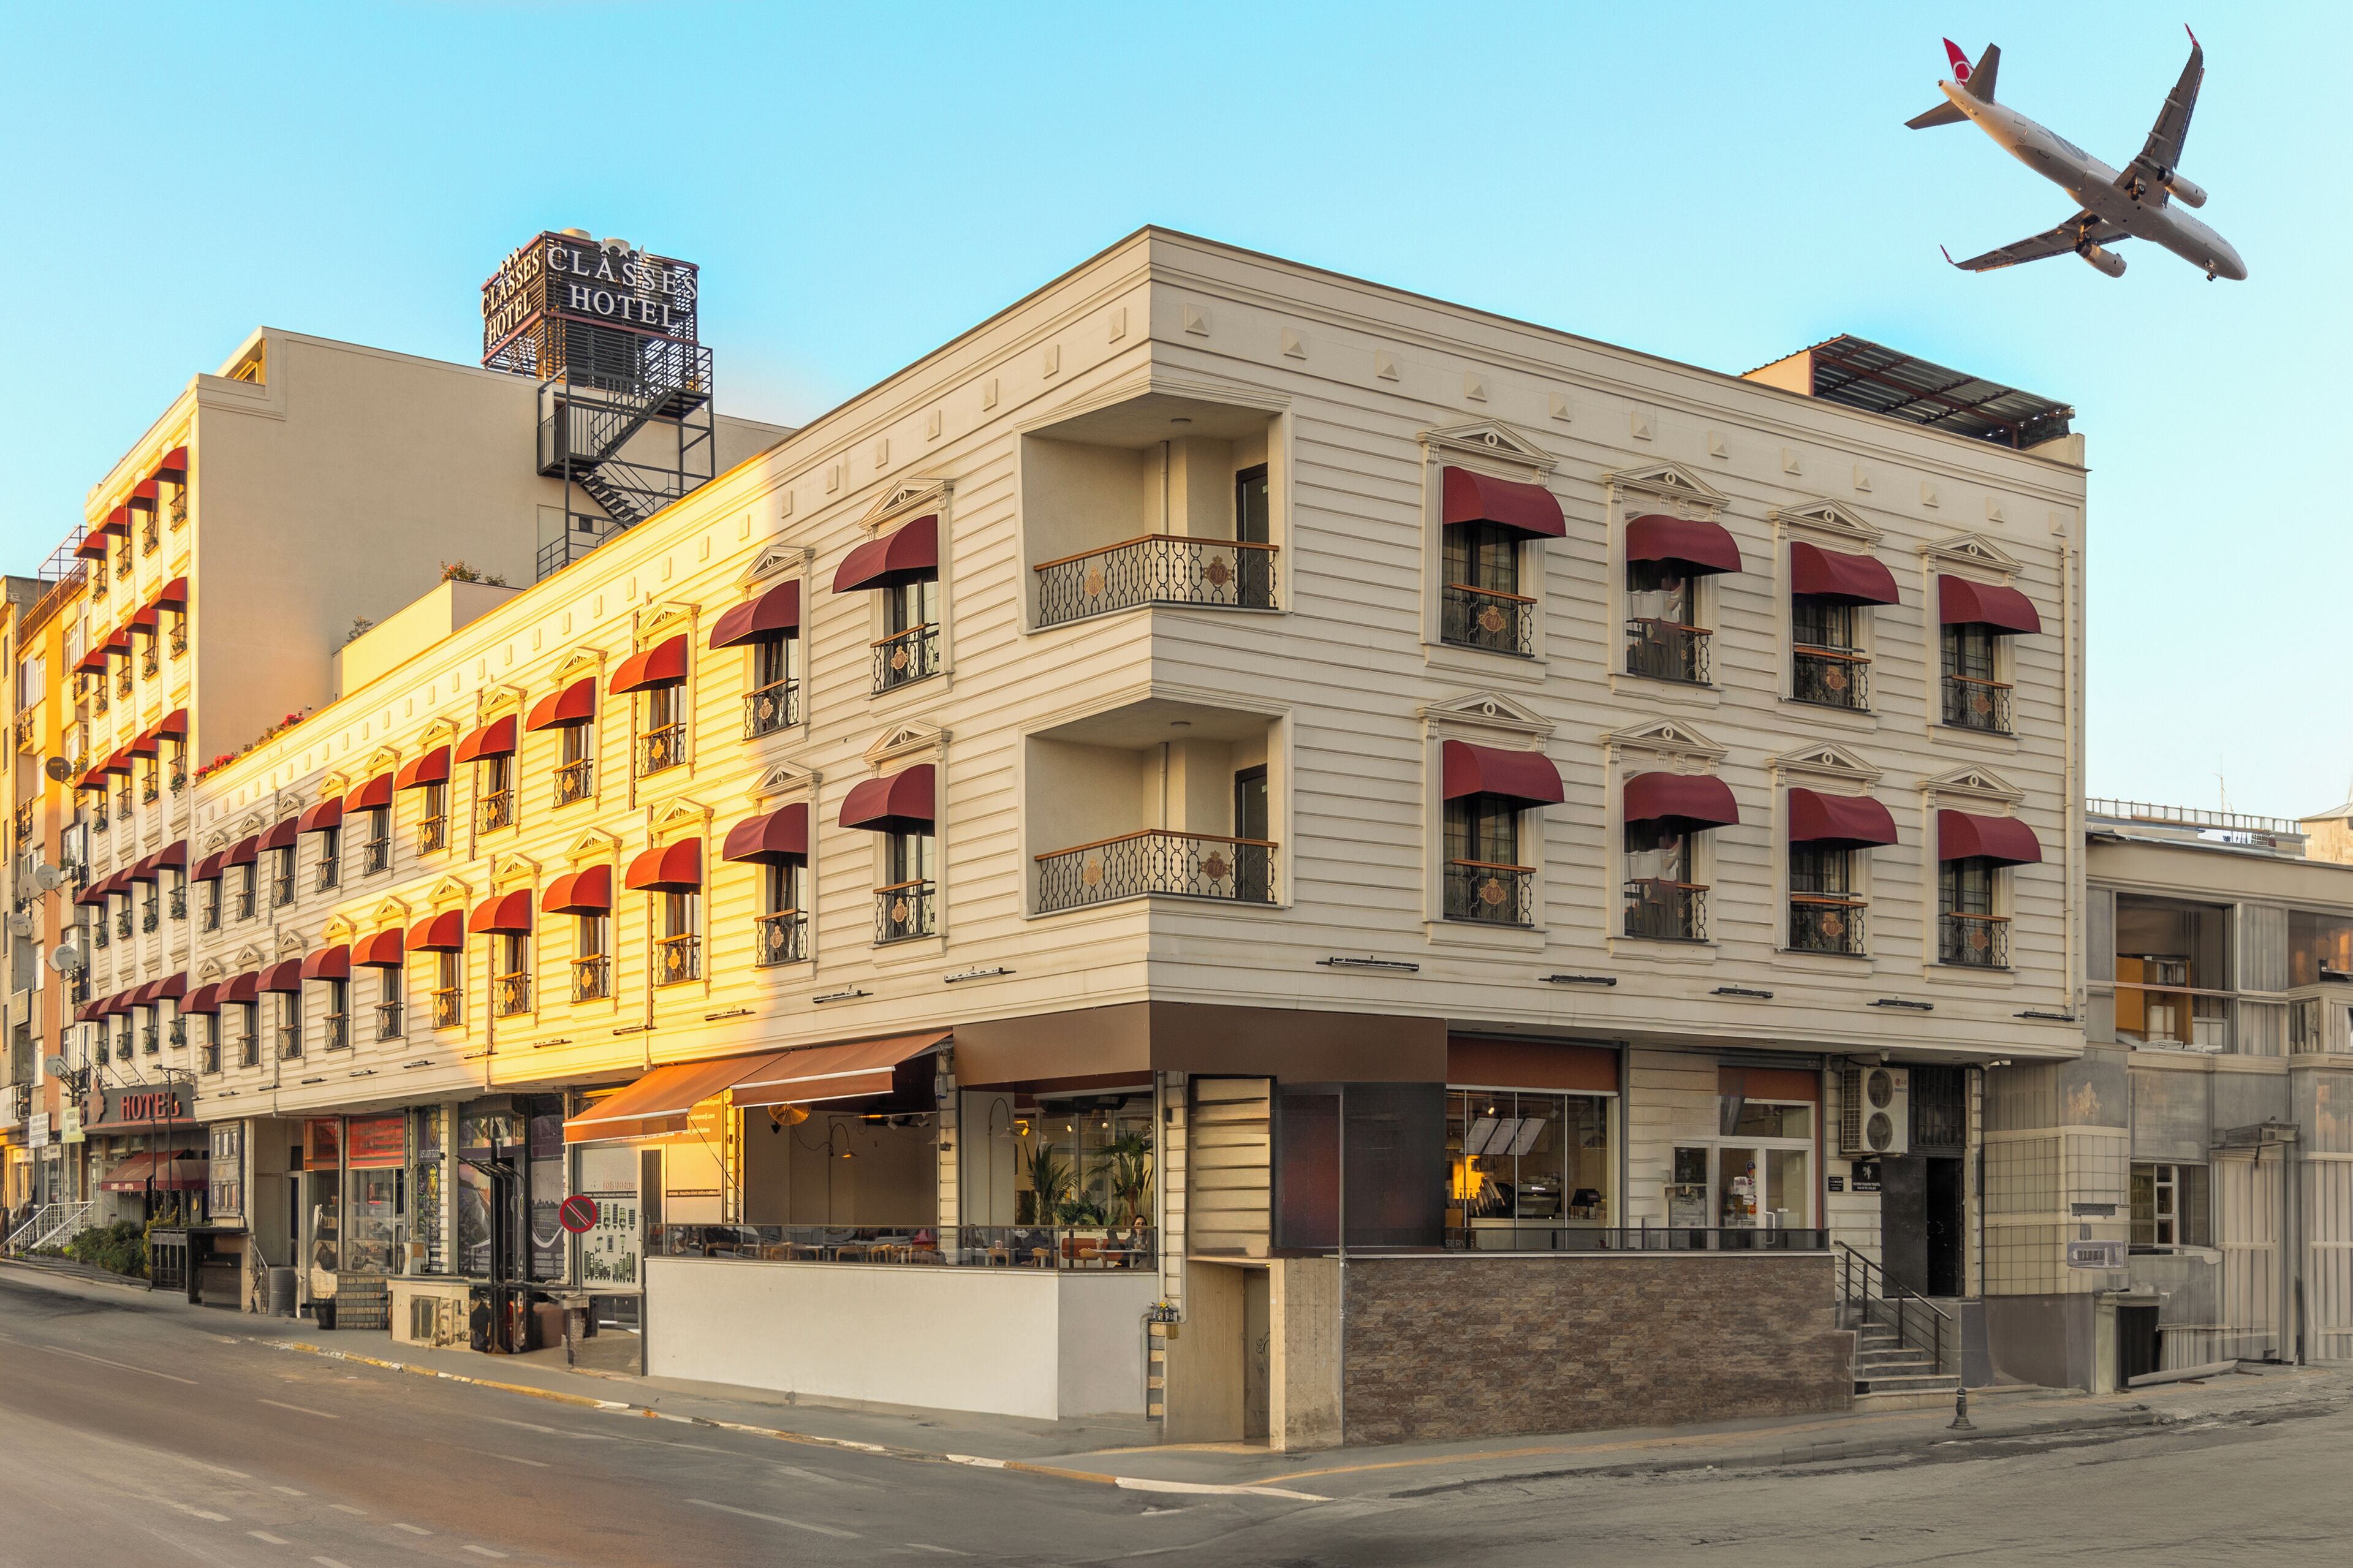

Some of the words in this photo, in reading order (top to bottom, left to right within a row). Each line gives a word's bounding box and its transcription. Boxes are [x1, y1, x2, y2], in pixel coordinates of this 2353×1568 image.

[481, 248, 540, 318] CLASSES
[547, 246, 697, 300] CLASSES
[488, 290, 532, 345] HOTEL
[569, 284, 678, 328] HOTEL
[120, 1092, 180, 1120] HOTEL
[1445, 1239, 1474, 1248] SERVS
